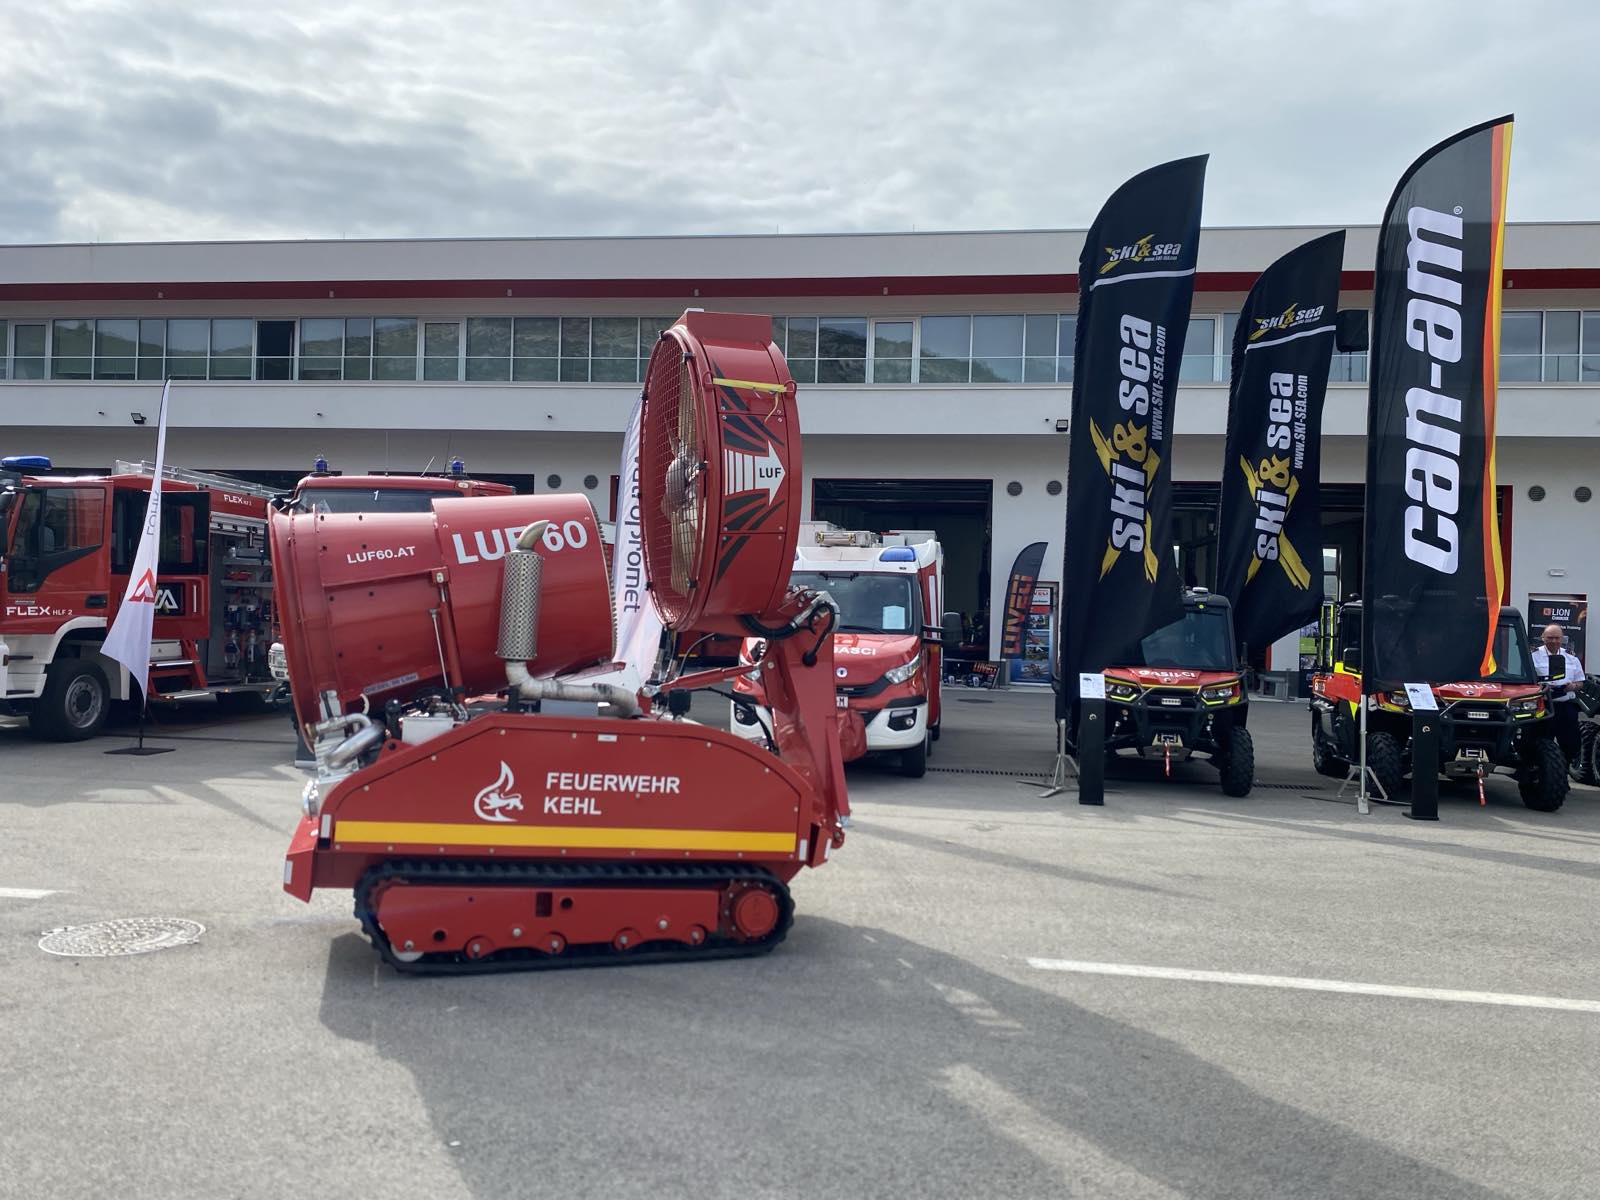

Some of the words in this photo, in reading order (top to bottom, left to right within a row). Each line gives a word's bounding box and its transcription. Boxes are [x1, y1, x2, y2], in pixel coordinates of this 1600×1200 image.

[1404, 206, 1463, 575] can-am
[759, 467, 782, 479] LUF
[223, 494, 243, 504] FLEX
[542, 520, 588, 552] 60
[347, 546, 416, 564] LUF60.AT
[6, 606, 51, 616] FLEX
[1552, 608, 1571, 617] LION
[545, 772, 680, 794] FEUERWEHR
[543, 796, 602, 815] KEHL
